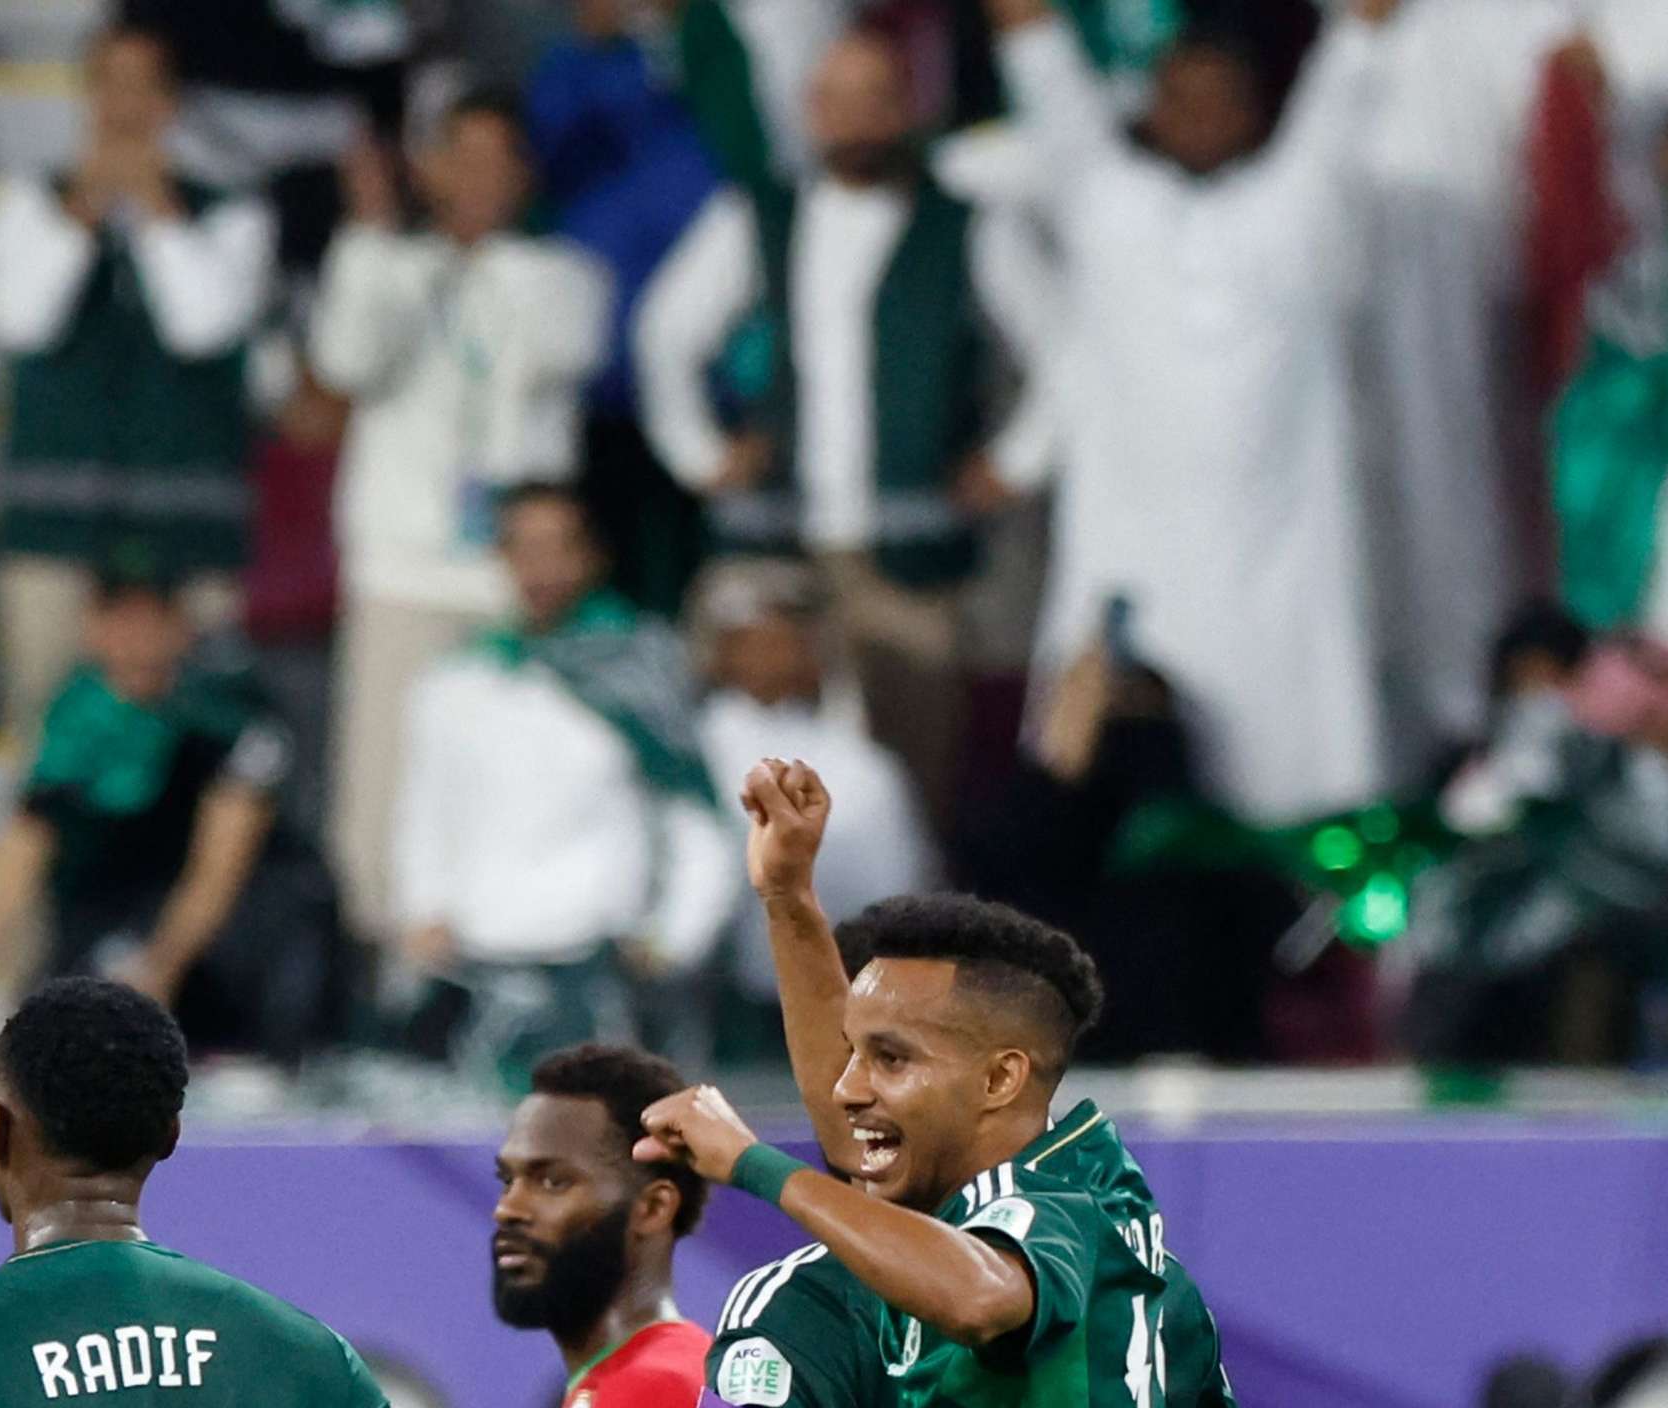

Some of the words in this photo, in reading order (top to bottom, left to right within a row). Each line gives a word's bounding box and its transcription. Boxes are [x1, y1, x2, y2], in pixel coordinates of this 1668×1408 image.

[32, 1325, 217, 1399] RADIF
[733, 1347, 762, 1360] AFC
[730, 1359, 781, 1378] LIVE
